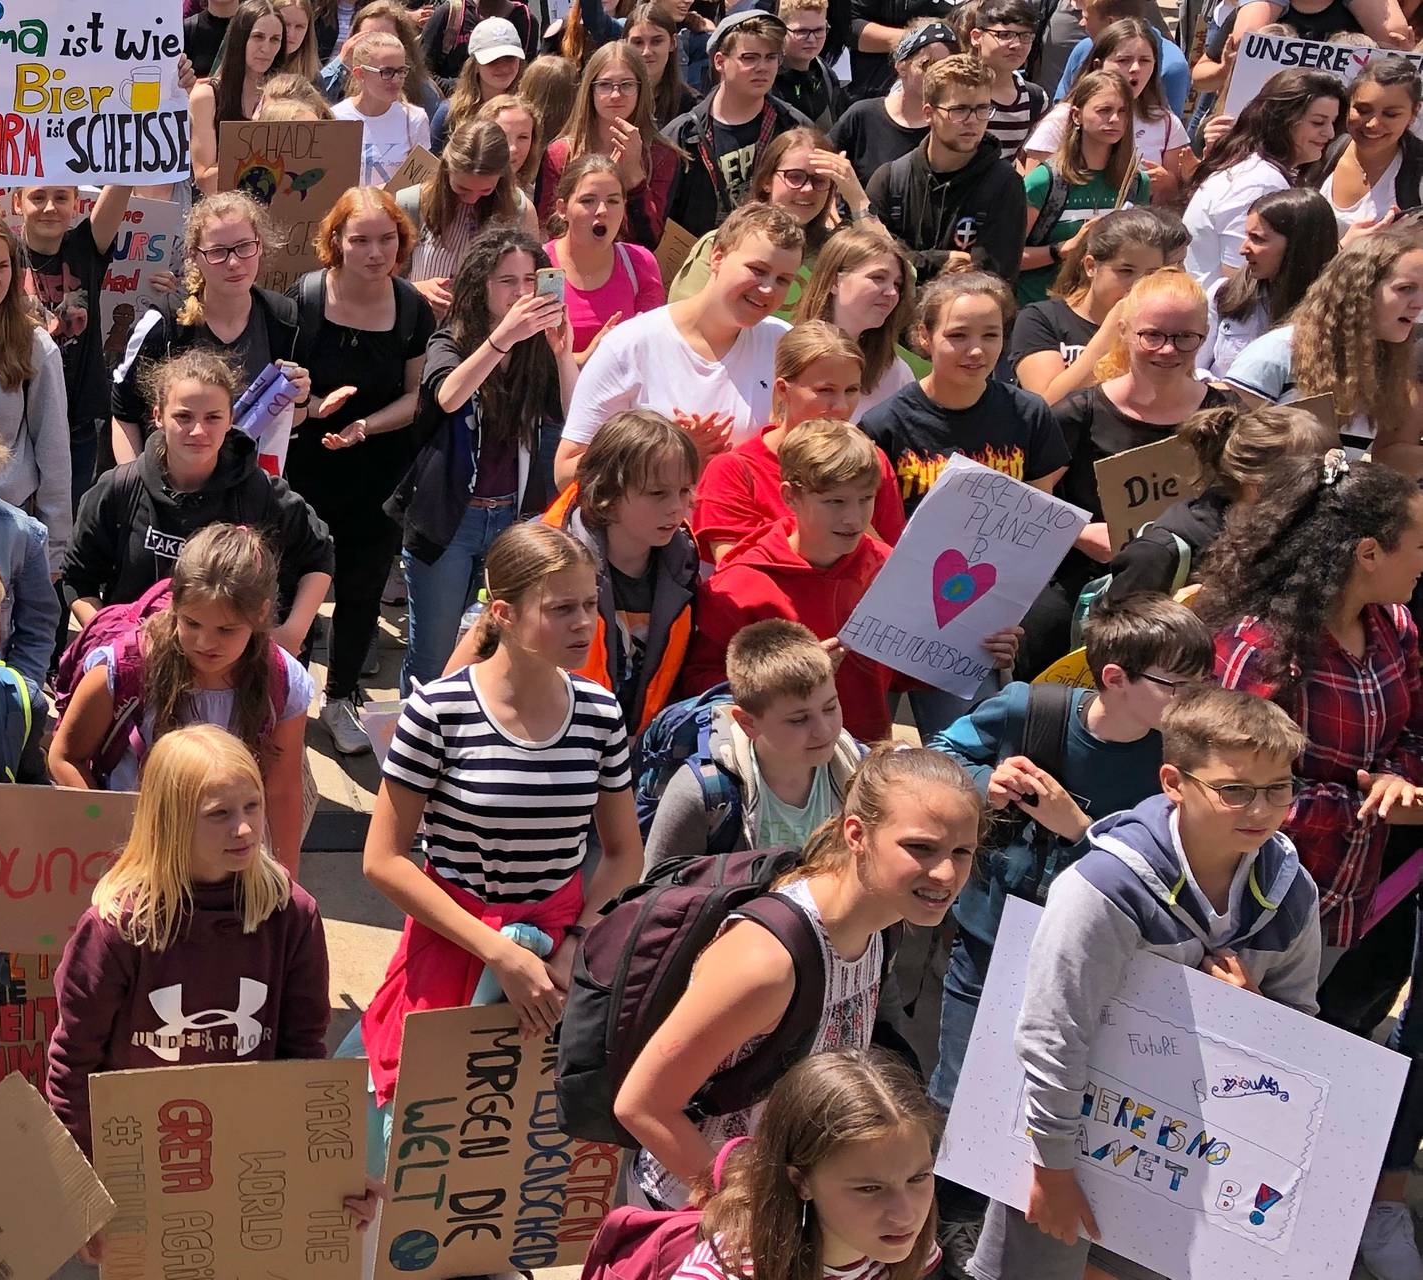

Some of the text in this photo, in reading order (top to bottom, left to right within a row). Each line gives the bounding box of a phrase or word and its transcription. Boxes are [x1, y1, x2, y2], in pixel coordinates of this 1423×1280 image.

[59, 12, 104, 56] ist
[1245, 35, 1354, 72] UNSERE
[13, 63, 114, 114] Bier
[46, 118, 65, 138] ist
[66, 110, 190, 174] SCHEISSE
[235, 123, 326, 161] SCHADE
[1014, 486, 1033, 515] IS
[1037, 501, 1077, 529] NO
[1123, 472, 1179, 508] Die
[963, 501, 1050, 549] PLANET
[967, 537, 989, 563] B
[132, 1030, 211, 1048] UNDER
[157, 1098, 215, 1195] GRETA
[392, 1096, 459, 1210] WELT
[442, 1027, 523, 1248] MORGEN DIE
[1156, 1114, 1189, 1153] IS
[1185, 1129, 1232, 1167] NO
[305, 1079, 354, 1265] MAKE THE
[558, 1136, 620, 1242] RETTEN
[238, 1150, 287, 1252] WORLD
